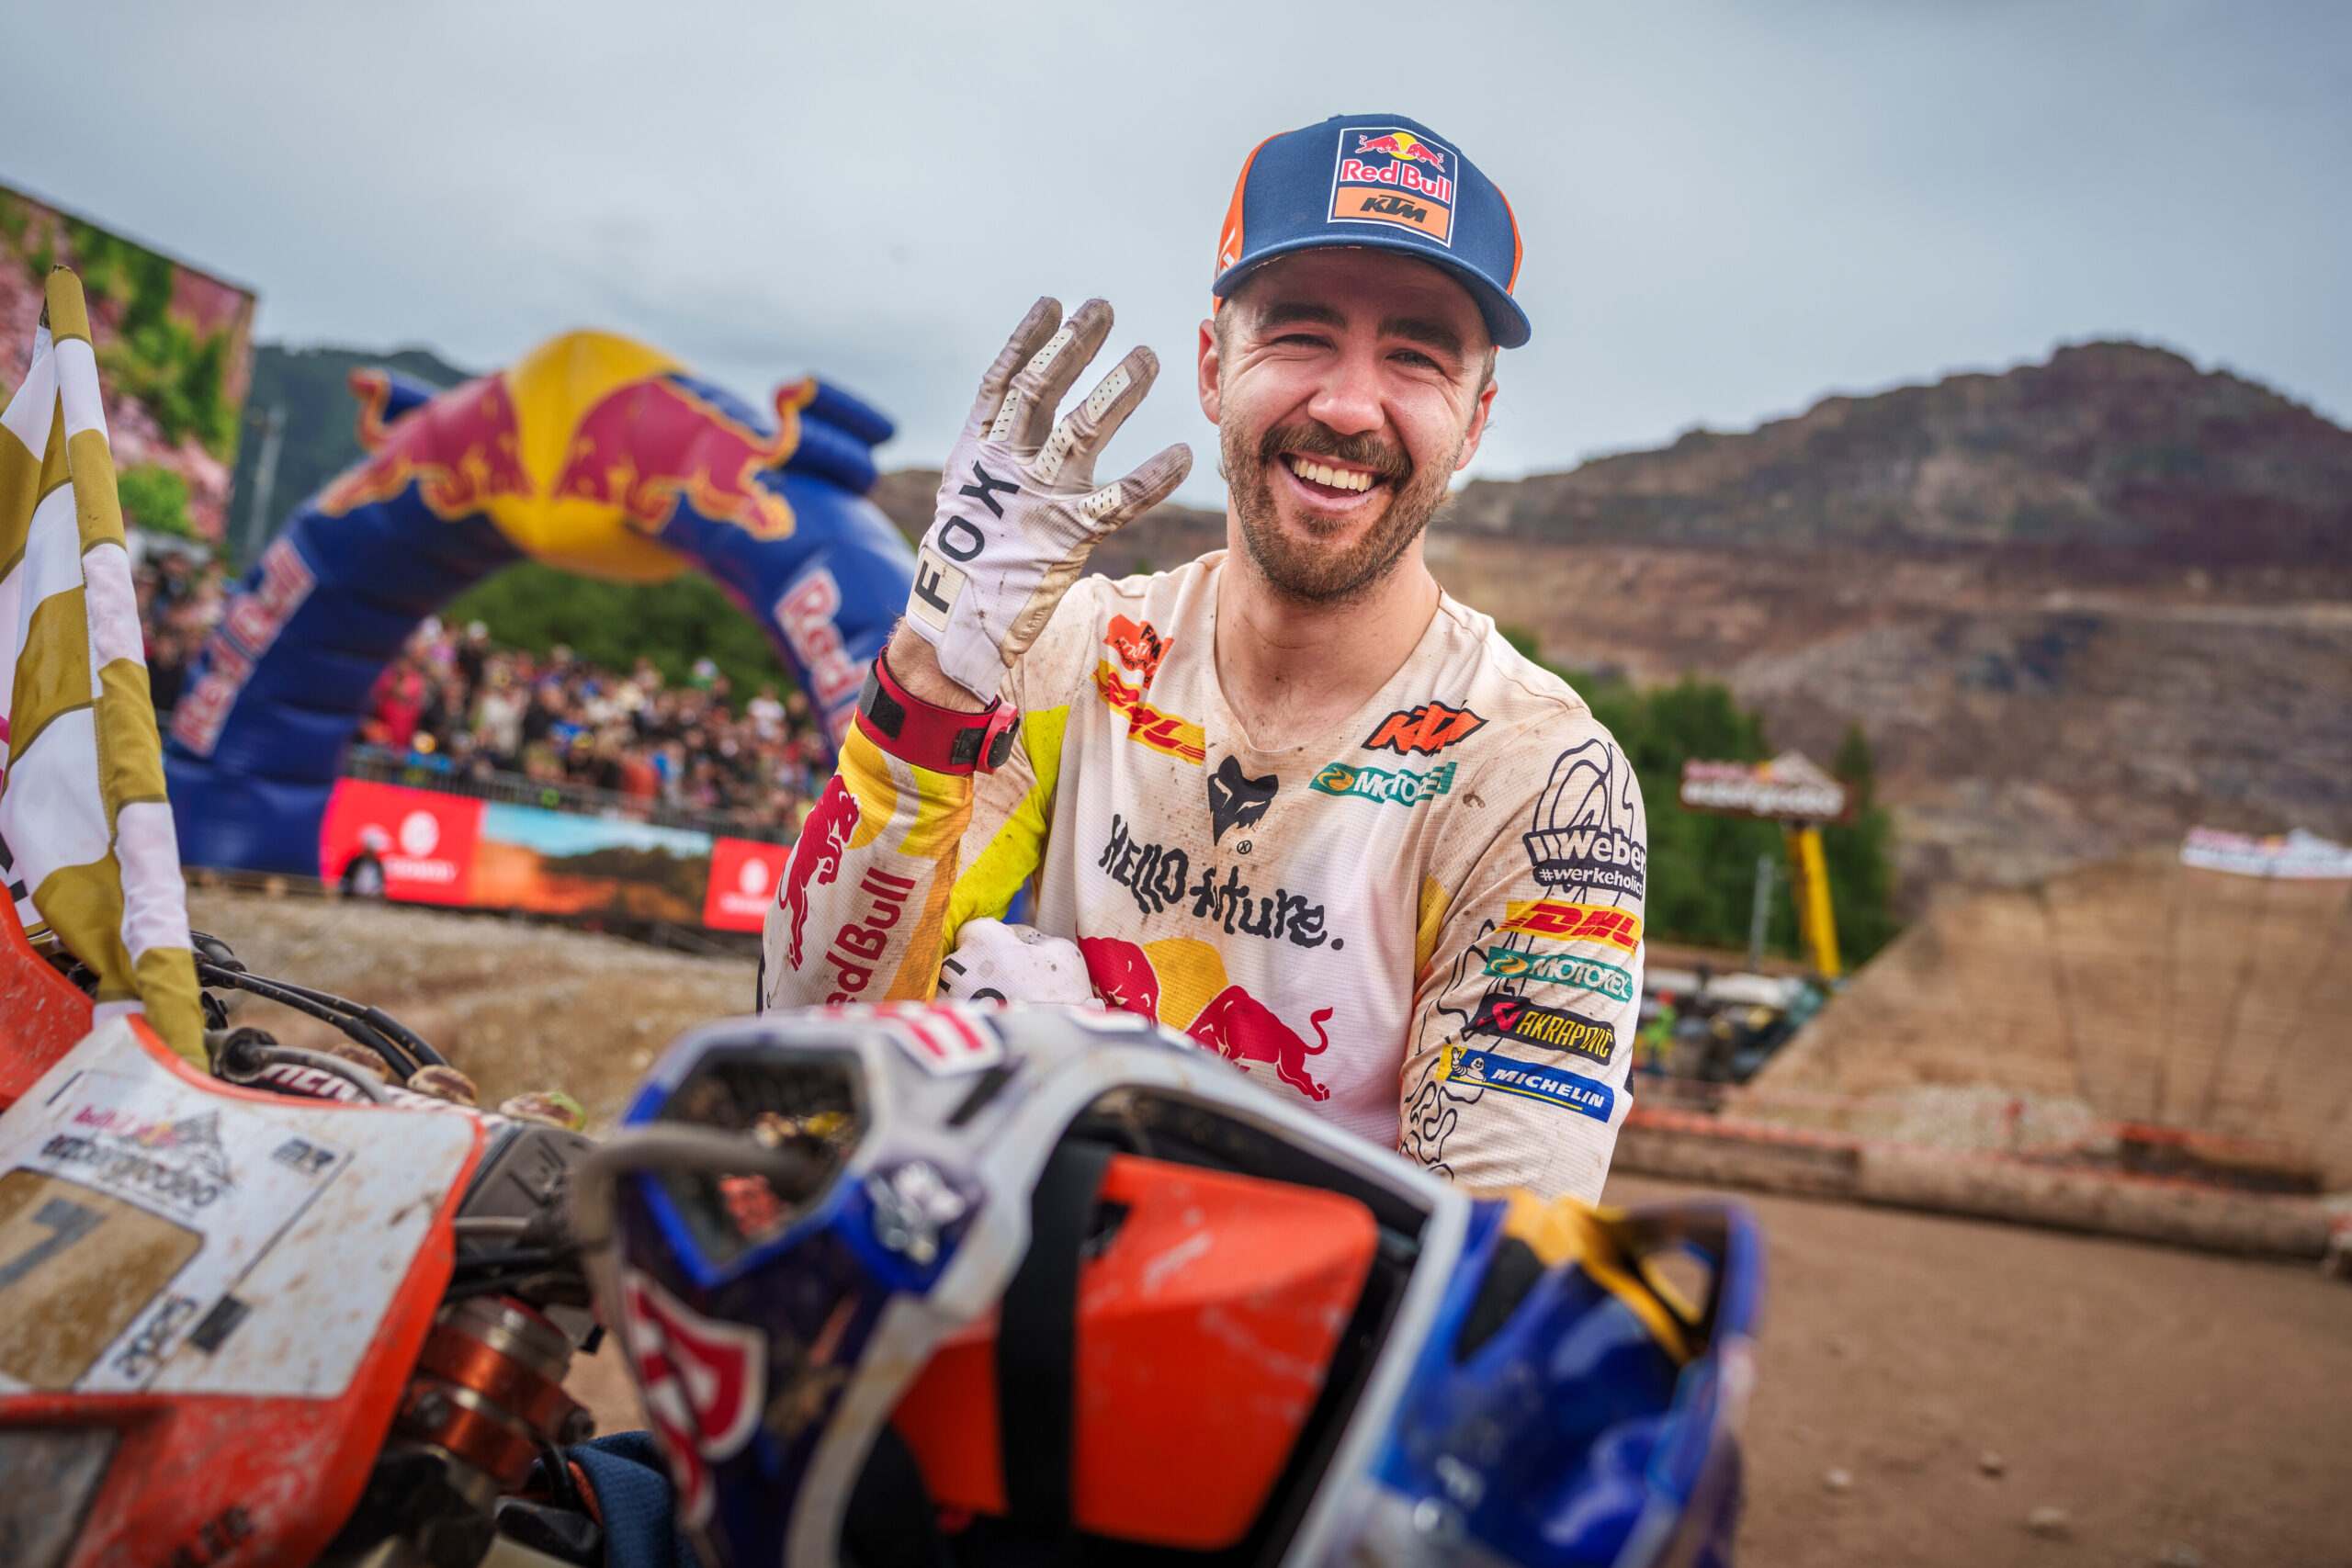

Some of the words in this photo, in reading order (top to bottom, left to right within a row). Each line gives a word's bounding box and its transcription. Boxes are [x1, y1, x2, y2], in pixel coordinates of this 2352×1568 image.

[1340, 159, 1399, 184] Red
[1400, 163, 1452, 204] Bull
[1360, 194, 1428, 223] KTM
[914, 460, 1020, 614] FOX
[1353, 770, 1442, 803] MOTOE
[1539, 867, 1643, 896] #werkeholics
[835, 867, 916, 961] Bull
[1521, 902, 1634, 947] DHL
[1490, 1069, 1605, 1108] MICHELIN
